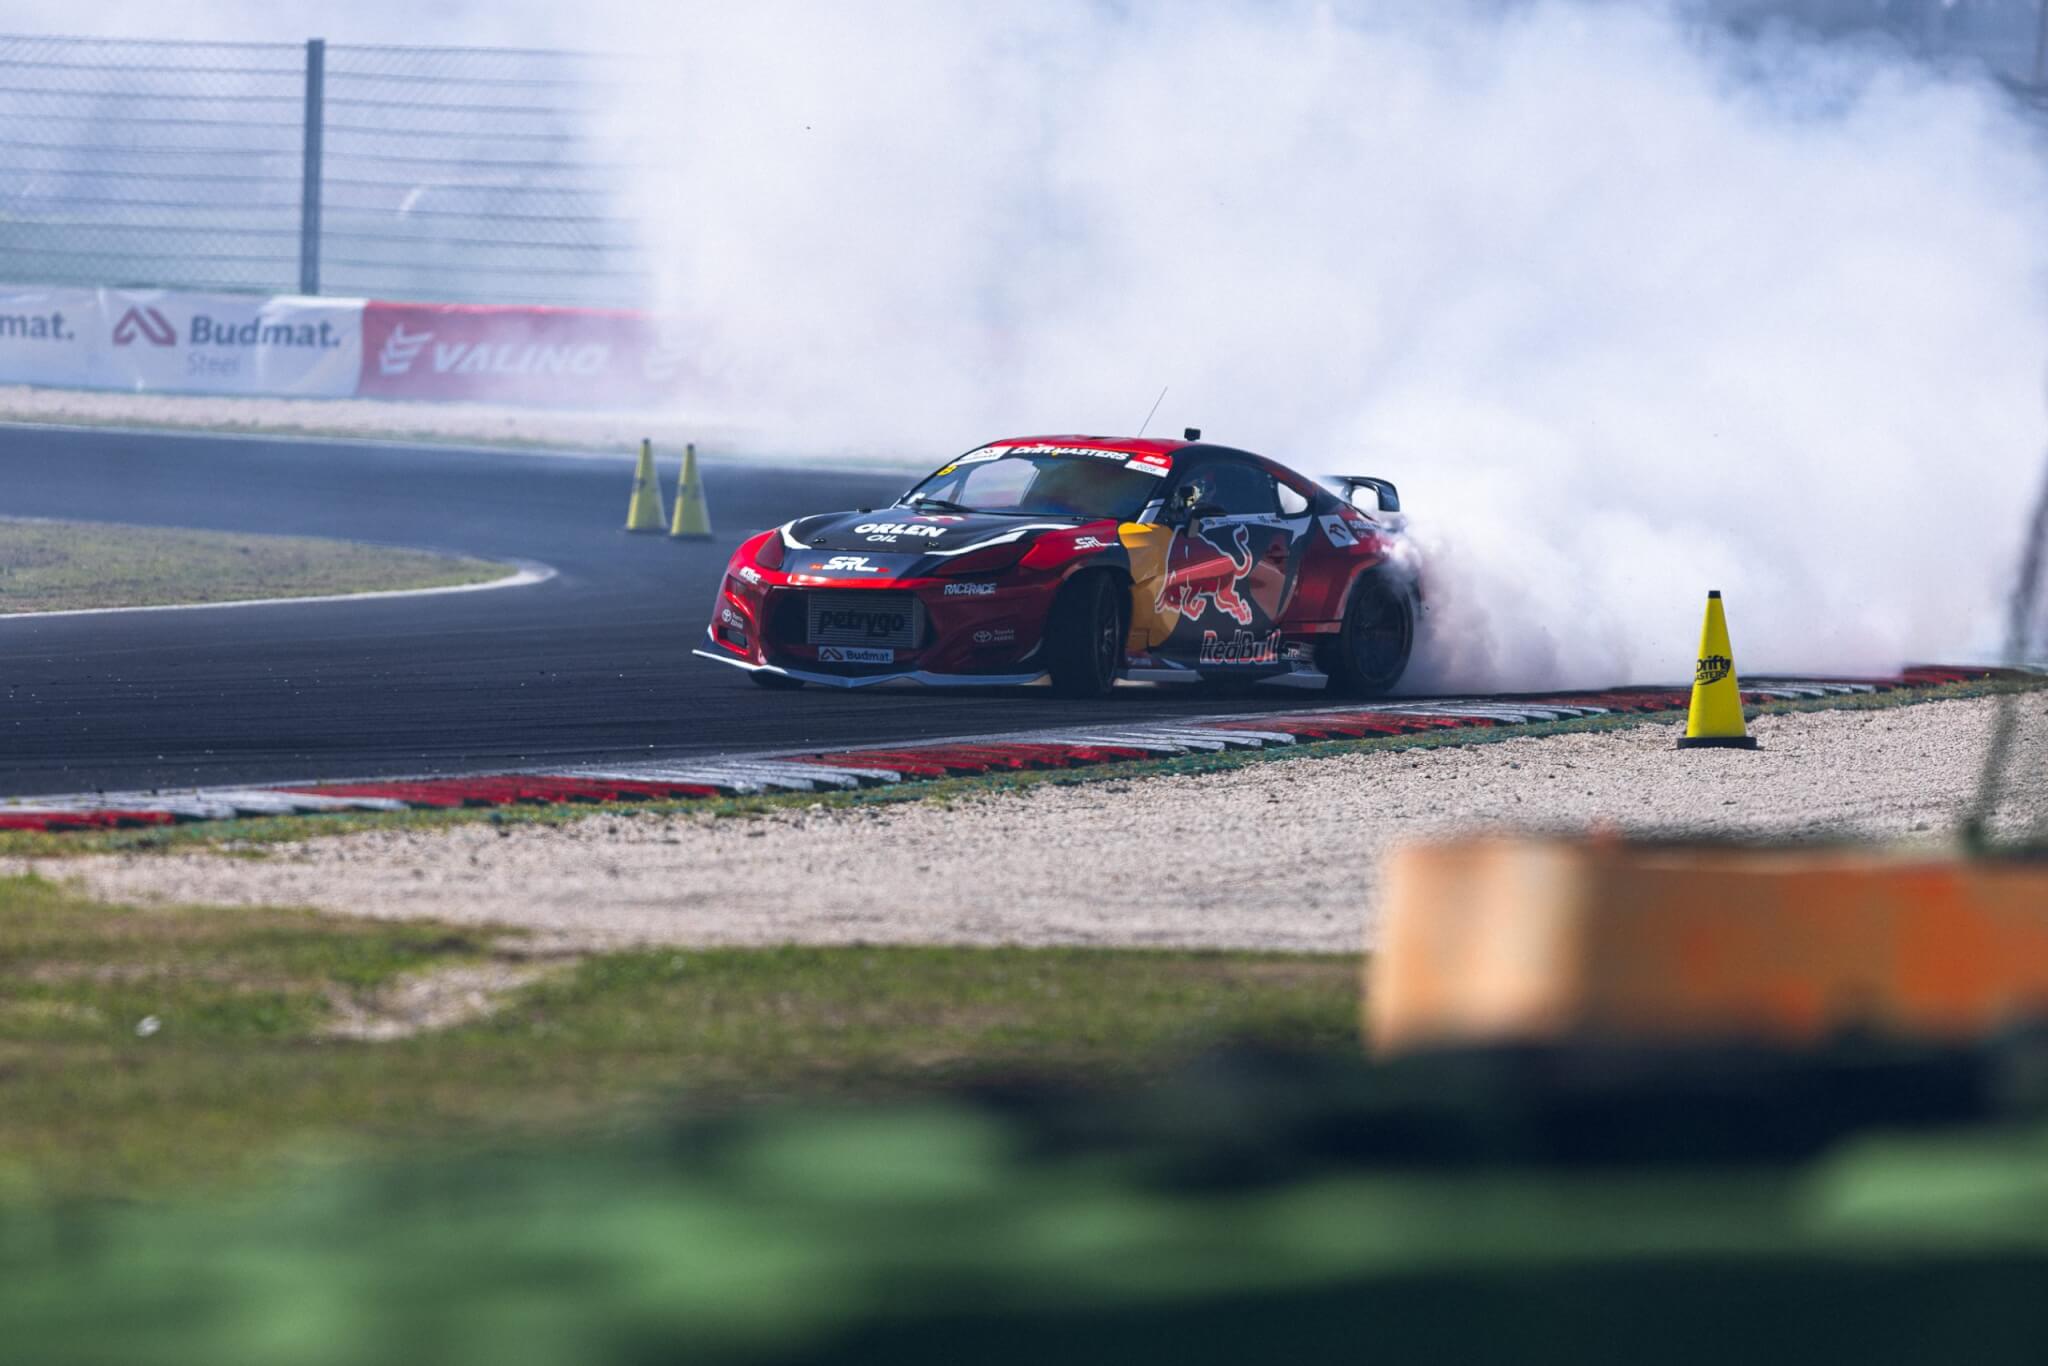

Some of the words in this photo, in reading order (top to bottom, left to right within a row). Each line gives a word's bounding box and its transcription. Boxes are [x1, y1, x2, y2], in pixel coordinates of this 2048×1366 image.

[190, 315, 341, 347] Budmat.
[432, 344, 609, 375] VALINO
[854, 523, 947, 538] ORLEN
[866, 534, 897, 542] OIL
